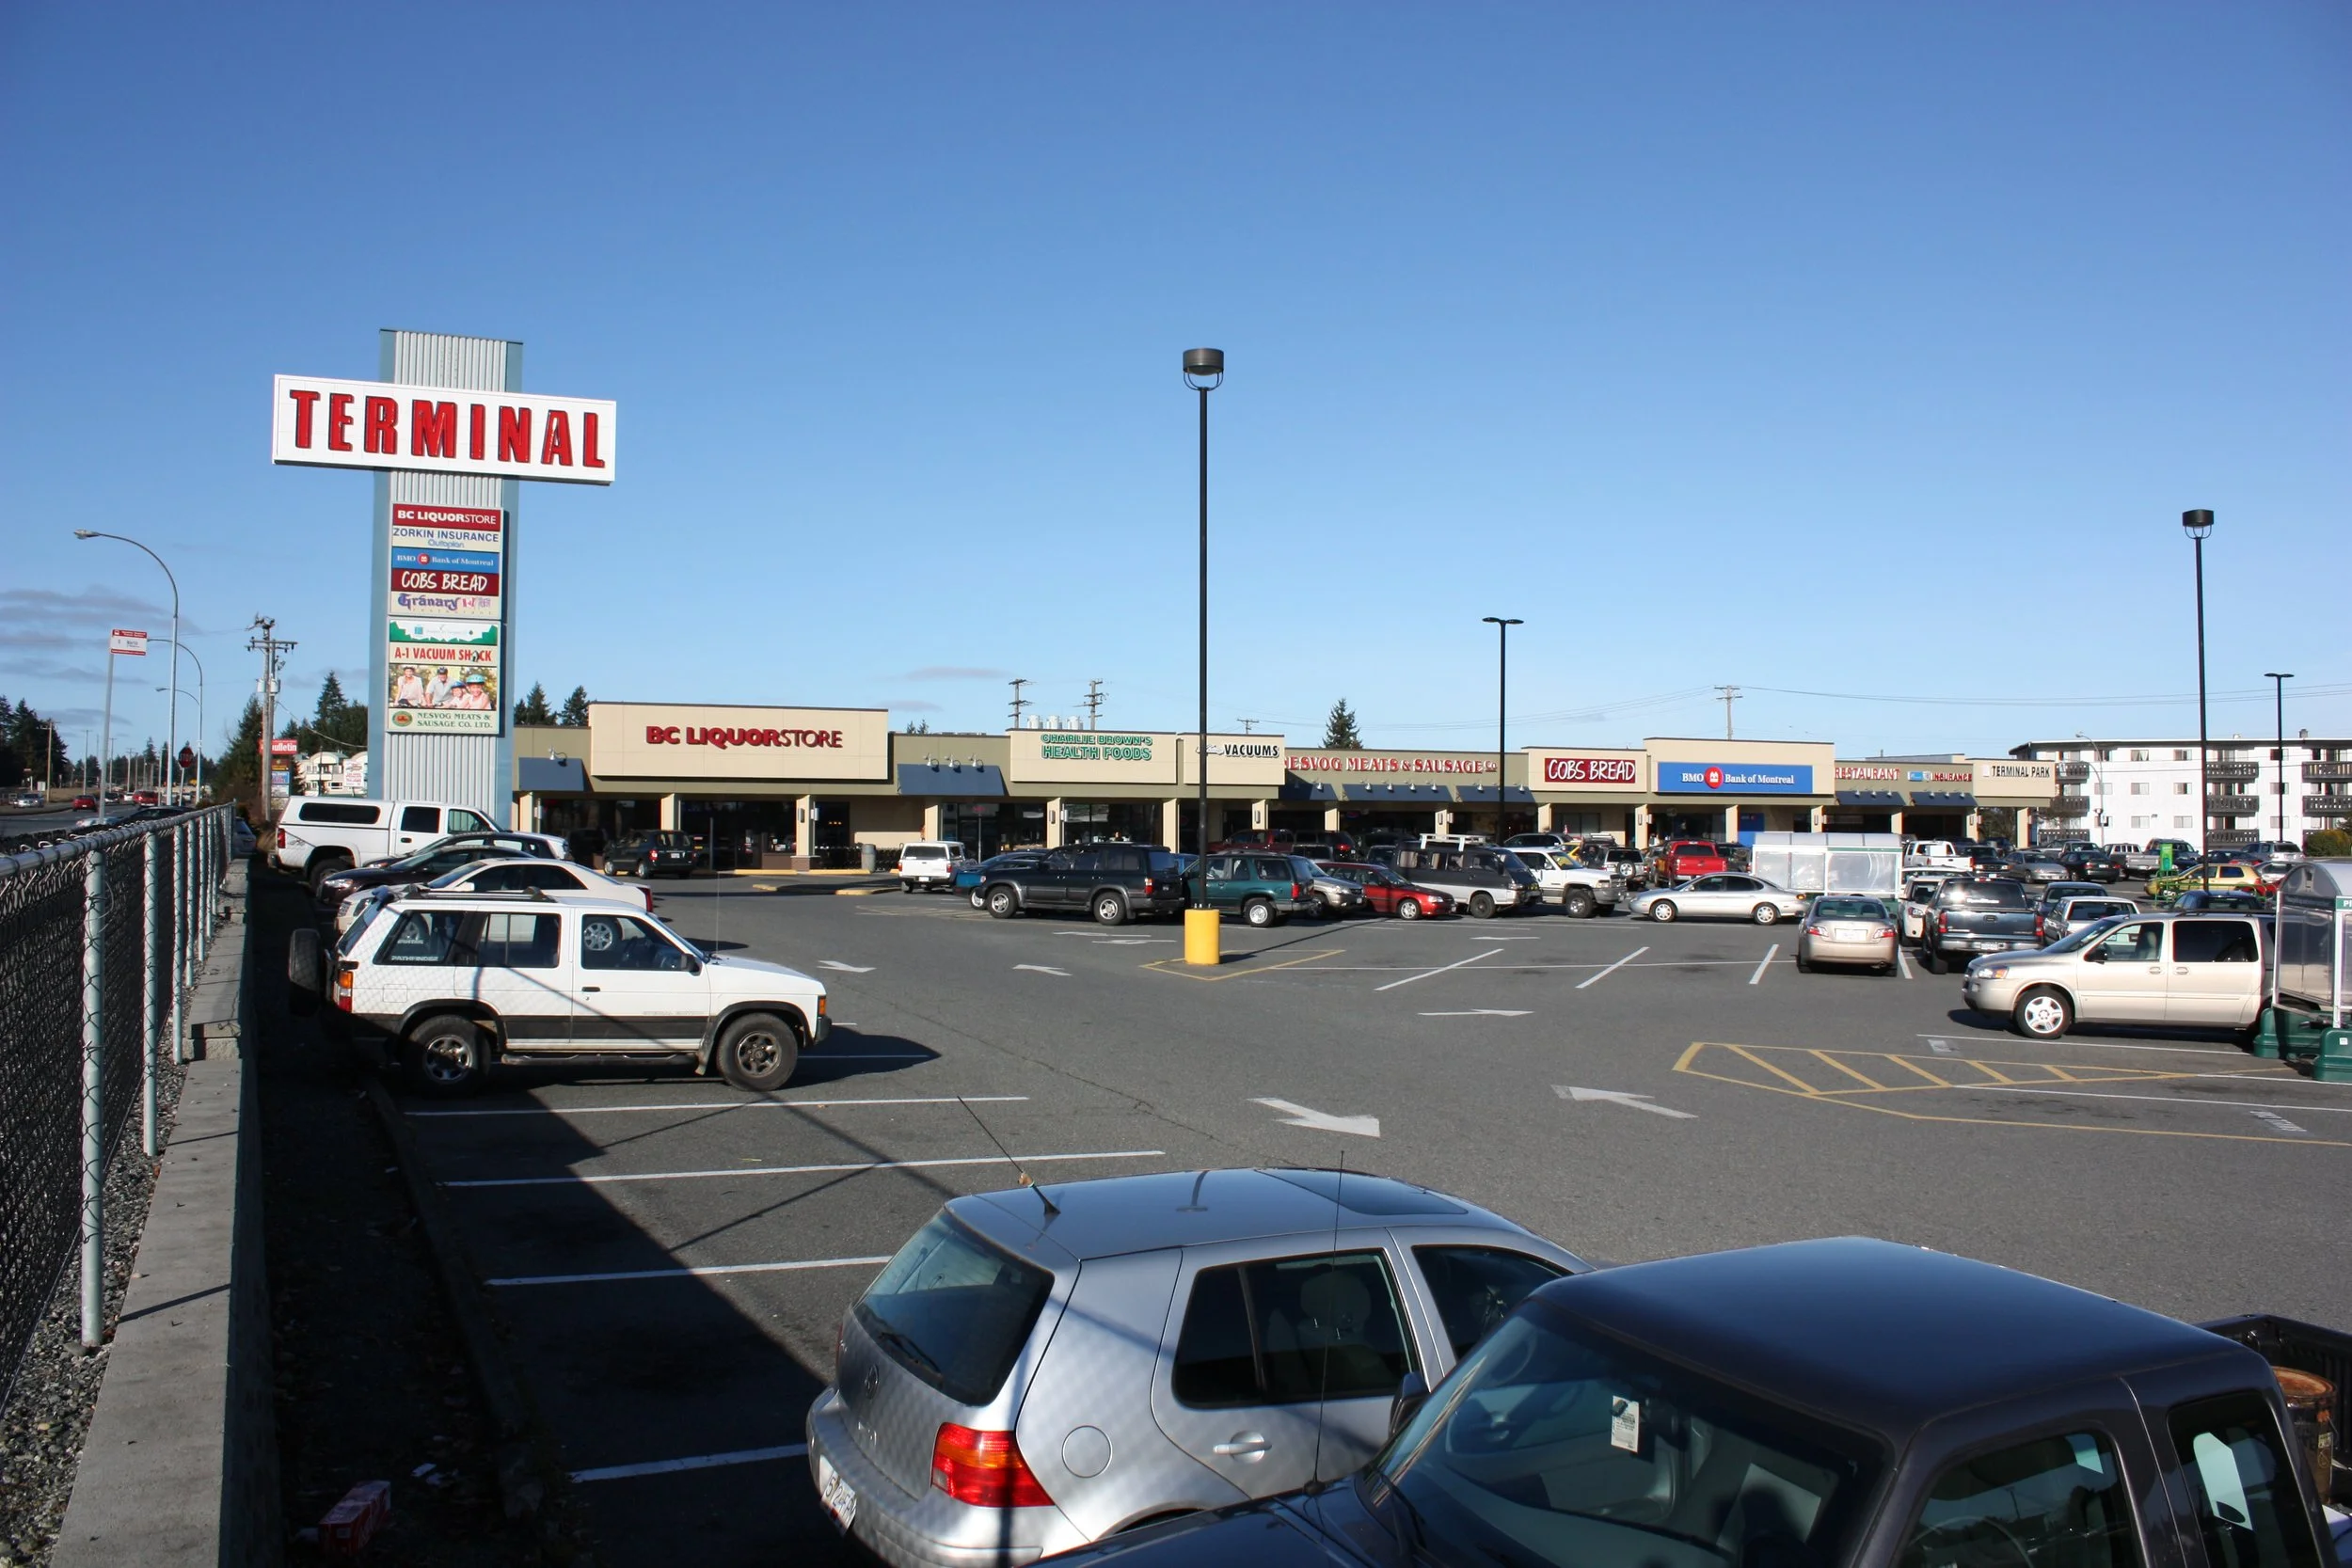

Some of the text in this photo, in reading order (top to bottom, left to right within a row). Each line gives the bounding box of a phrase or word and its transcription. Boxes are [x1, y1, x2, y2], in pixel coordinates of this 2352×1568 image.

[289, 388, 606, 468] TERMINAL
[397, 510, 415, 519] BC
[393, 528, 499, 543] ZORKIN INSURANCE
[432, 556, 452, 564] Bank
[460, 558, 494, 566] Montreal
[401, 570, 488, 592] COBS BREAD
[397, 593, 461, 611] Granary
[394, 646, 409, 658] A-1
[412, 647, 456, 661] VACUUM
[417, 720, 456, 728] SAUSAGE
[645, 725, 680, 745] BC
[1041, 734, 1153, 746] CHARLIE BROWN'S
[271, 742, 297, 752] ulletin
[1041, 745, 1152, 761] HEALTH FOODS
[1224, 744, 1279, 758] VACUUMS
[1345, 757, 1399, 772] MEATS
[1401, 759, 1412, 772] &
[1412, 758, 1484, 774] SAUSAGE
[1548, 759, 1637, 782] COBS BREAD
[1991, 765, 2051, 779] TERMINAL PARK
[1681, 772, 1794, 784] BMO Bank of Montreal
[1835, 767, 1900, 781] RESTAURANT
[1931, 771, 1973, 783] INSURANCE
